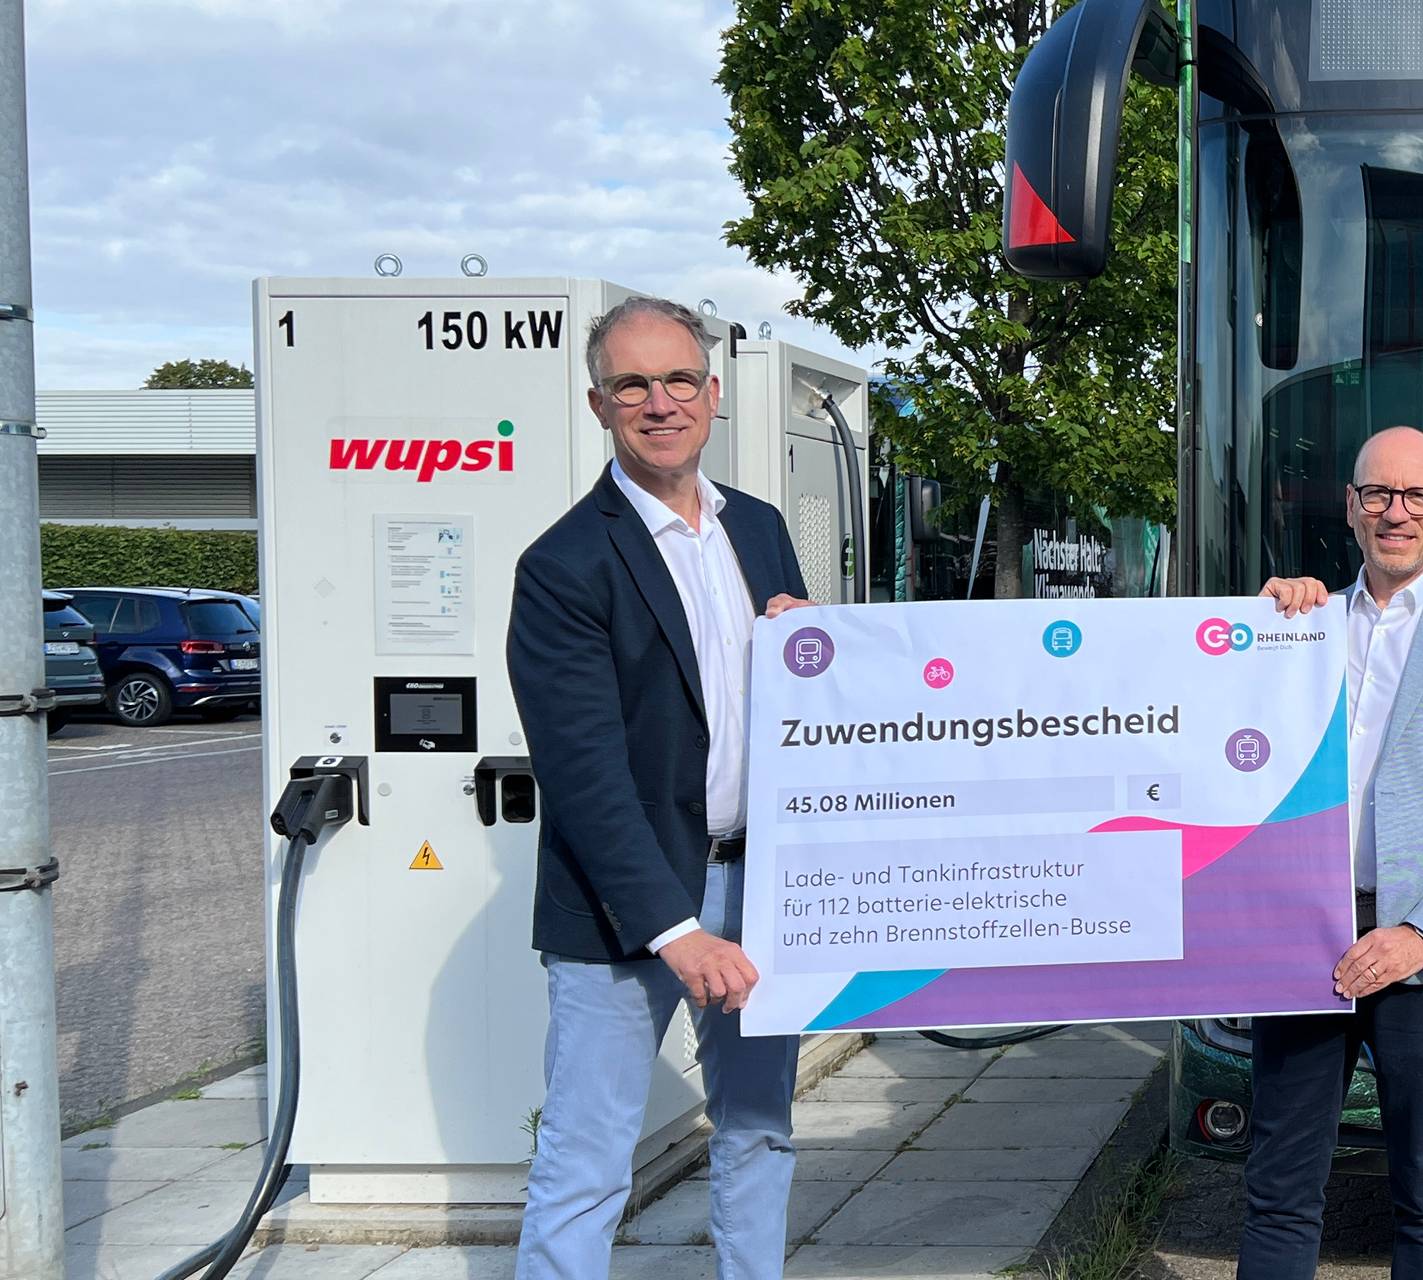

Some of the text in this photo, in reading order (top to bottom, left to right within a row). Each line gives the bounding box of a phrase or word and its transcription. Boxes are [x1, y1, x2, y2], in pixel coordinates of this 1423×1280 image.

[278, 310, 295, 347] 1
[417, 310, 564, 350] 150 kW
[328, 419, 515, 483] wupsi
[1257, 631, 1326, 642] RHEINLAND
[780, 705, 1179, 747] Zuwendungsbescheid
[785, 783, 1160, 814] 45,08 Millionen €
[784, 859, 1085, 888] Lade- und Tankinfrastruktur
[783, 888, 1068, 917] für 112 batterie-elektrische
[783, 917, 1132, 946] und zehn Brennstoffzellen-Busse
